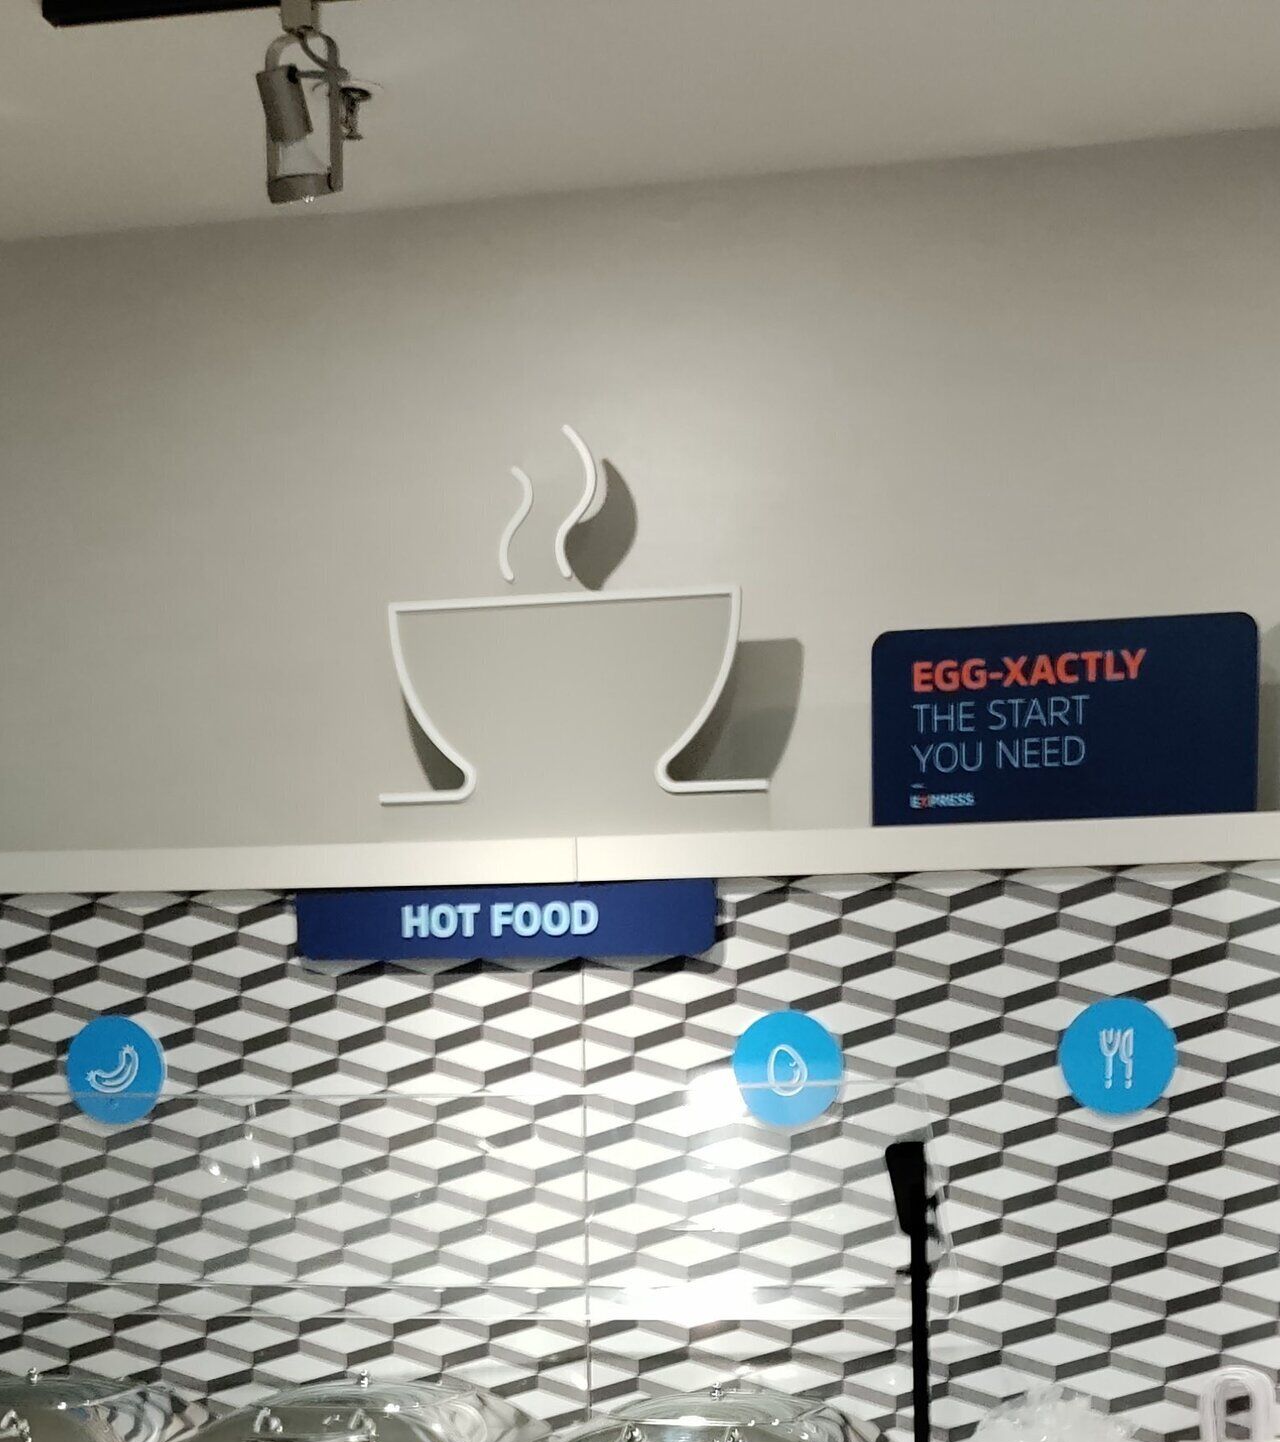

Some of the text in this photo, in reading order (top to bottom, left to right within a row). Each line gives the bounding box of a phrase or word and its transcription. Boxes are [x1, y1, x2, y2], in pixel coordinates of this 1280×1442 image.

[911, 648, 1148, 693] EGG-XACTLY
[911, 694, 1091, 734] THE START
[910, 735, 1087, 774] YOU NEED
[400, 899, 600, 939] HOT FOOD
